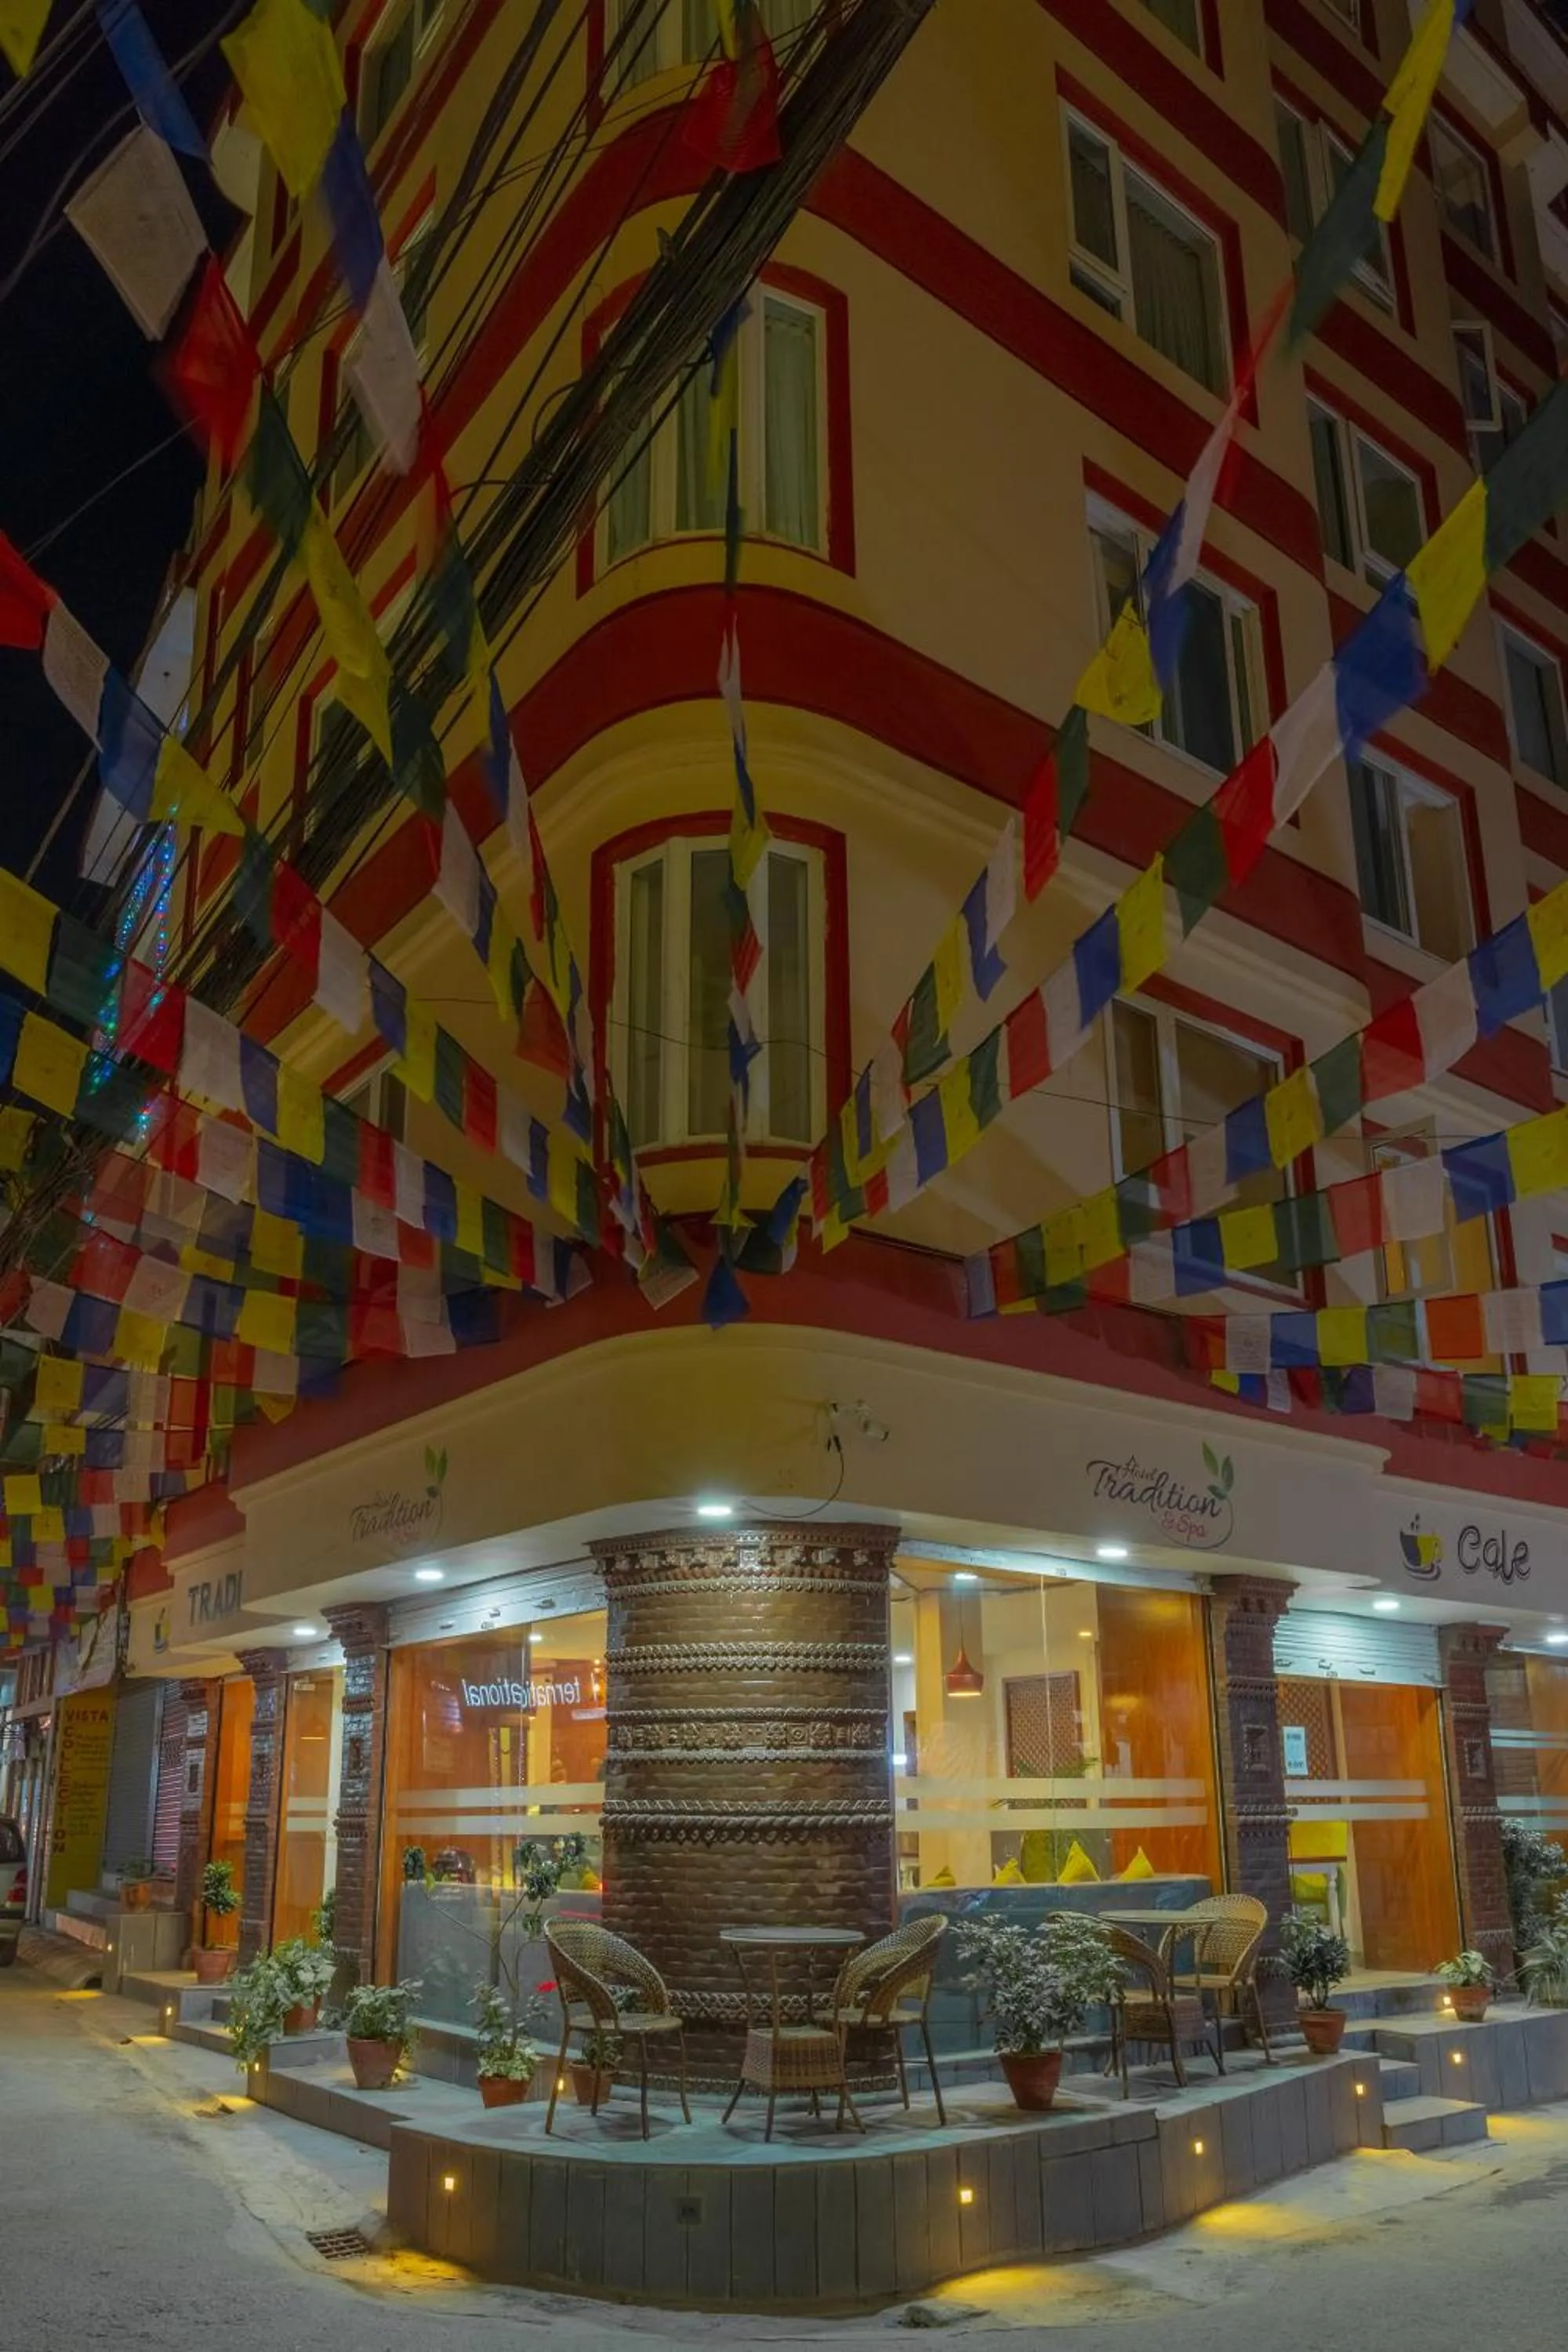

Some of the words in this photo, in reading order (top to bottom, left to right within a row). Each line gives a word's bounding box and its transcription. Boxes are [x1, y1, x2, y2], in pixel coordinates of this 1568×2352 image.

[1086, 1459, 1221, 1518] Tradition
[1457, 1524, 1531, 1585] Cafe
[65, 1708, 108, 1722] VISTA
